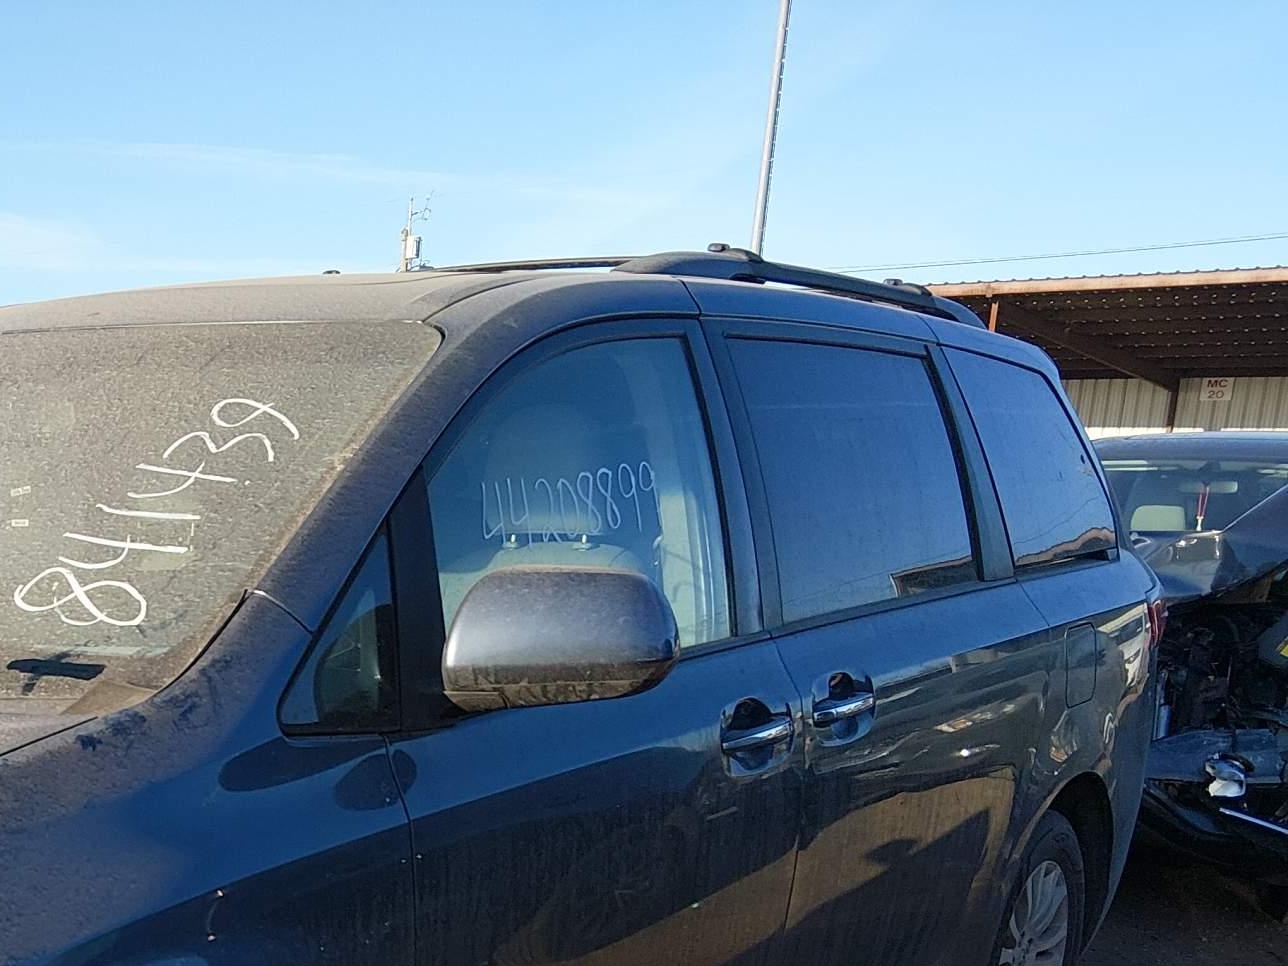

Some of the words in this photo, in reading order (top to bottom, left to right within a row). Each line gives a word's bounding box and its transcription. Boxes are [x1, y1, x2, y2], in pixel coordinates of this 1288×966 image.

[1207, 379, 1228, 388] MC
[1207, 390, 1225, 399] 20
[480, 460, 664, 549] 44208899
